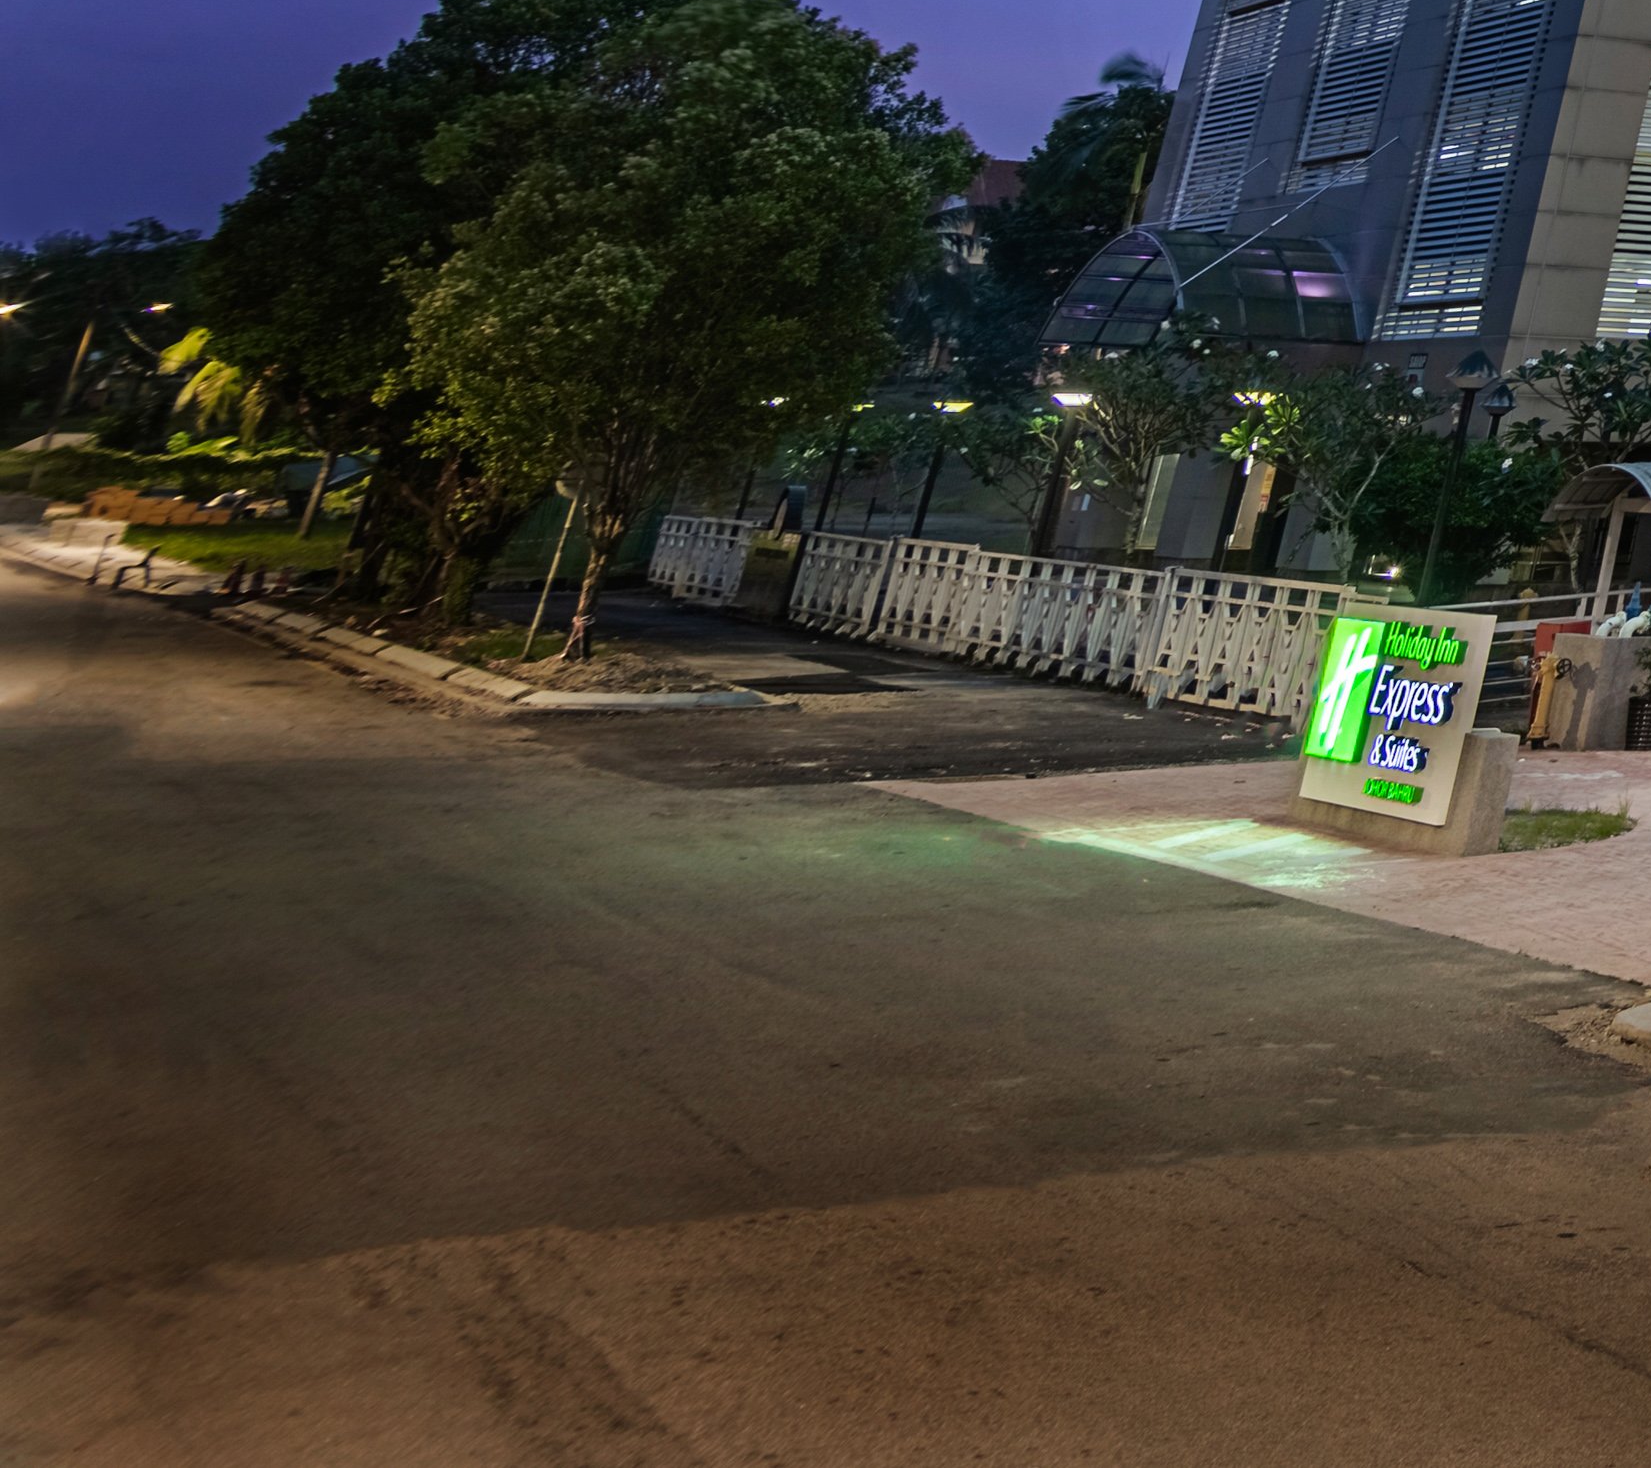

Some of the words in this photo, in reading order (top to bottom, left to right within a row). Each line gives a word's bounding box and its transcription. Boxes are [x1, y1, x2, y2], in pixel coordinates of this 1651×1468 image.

[1385, 622, 1438, 670] Holiday
[1435, 627, 1459, 664] Inn
[1369, 664, 1447, 731] Express
[1369, 734, 1382, 765] &
[1380, 736, 1420, 771] Suites
[1388, 781, 1416, 804] BAHRU
